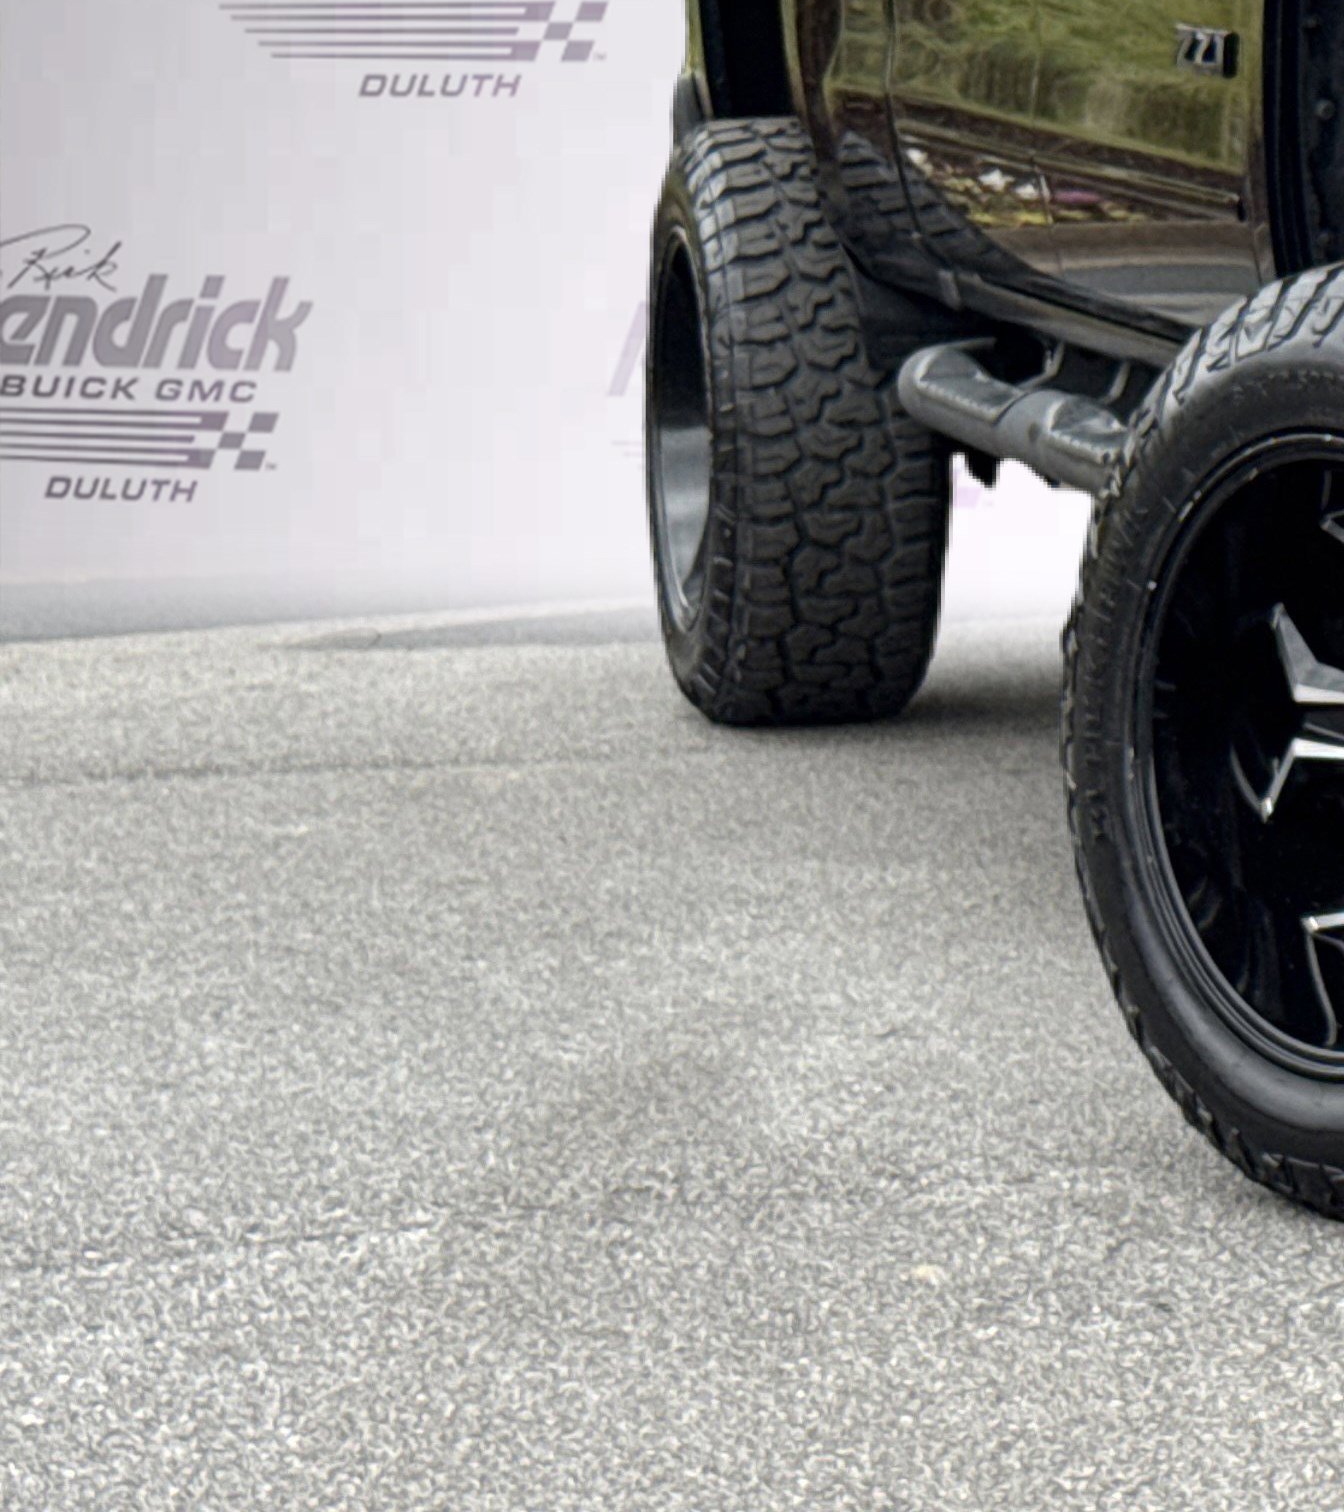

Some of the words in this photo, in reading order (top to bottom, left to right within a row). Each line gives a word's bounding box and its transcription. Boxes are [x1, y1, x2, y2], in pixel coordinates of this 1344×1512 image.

[358, 73, 523, 98] DULUTH
[0, 273, 314, 373] endrick
[0, 375, 139, 401] BUICK
[154, 379, 258, 404] GMC
[44, 475, 199, 503] DULUTH
